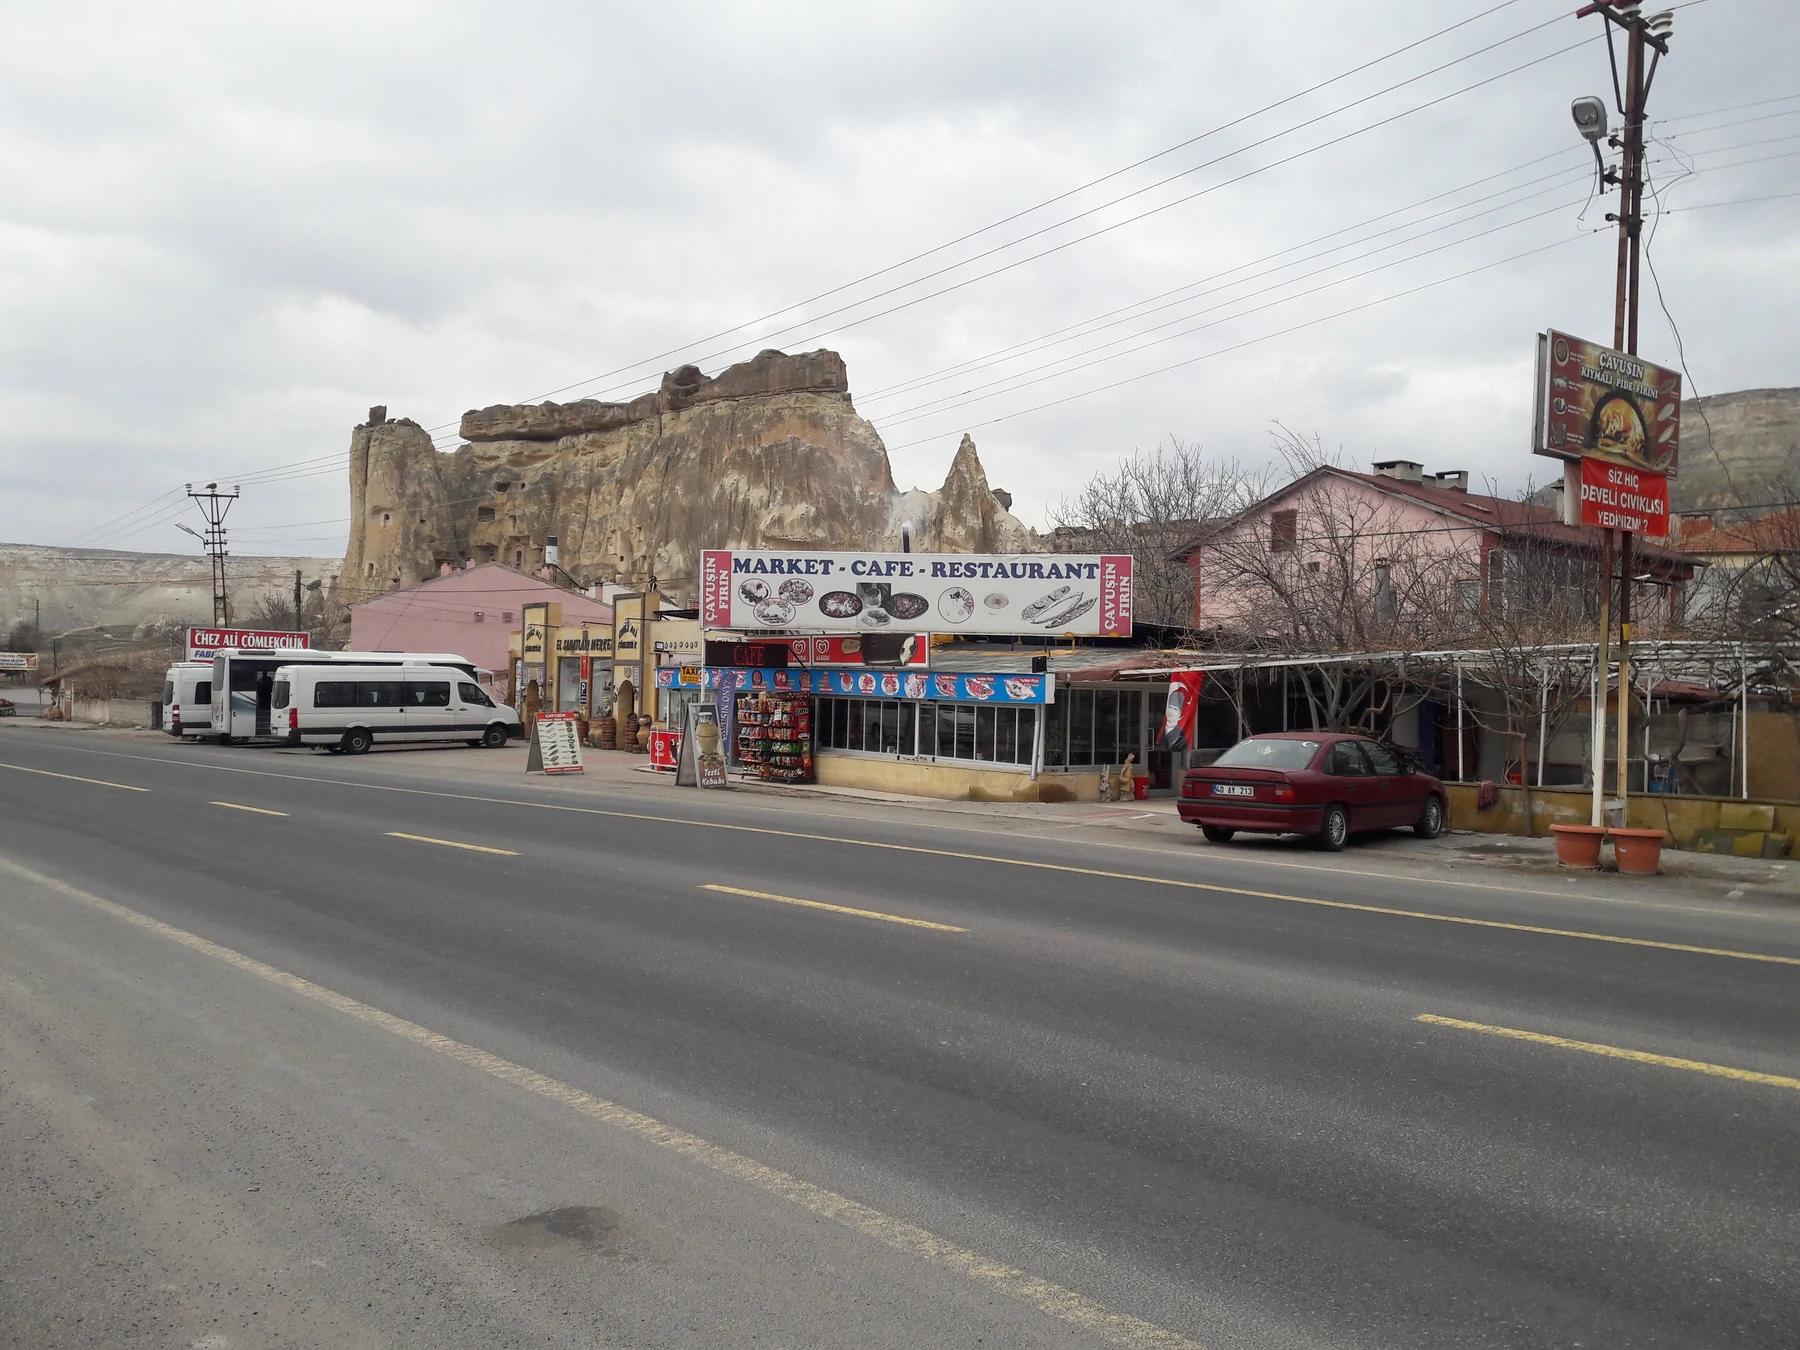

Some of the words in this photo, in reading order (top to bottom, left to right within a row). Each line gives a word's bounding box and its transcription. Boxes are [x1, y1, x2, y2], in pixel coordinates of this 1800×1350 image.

[1599, 352, 1644, 379] ÇAVUŞİN
[1581, 366, 1613, 385] KIYMALI
[1616, 376, 1633, 392] PİDE
[1636, 384, 1659, 399] FIRINI
[1608, 467, 1623, 485] SİZ
[1625, 470, 1639, 492] HİÇ
[1582, 484, 1618, 506] DEVELİ
[732, 558, 834, 575] MARKET
[851, 560, 913, 577] CAFE
[931, 562, 1100, 580] RESTAURANT
[705, 557, 717, 621] ÇAVUŞİN
[718, 569, 729, 609] FIRIN
[1104, 563, 1117, 630] ÇAVUŞİN
[1118, 575, 1131, 617] FIRIN
[195, 633, 220, 645] CHEZ
[223, 632, 238, 647] ALİ
[591, 638, 612, 651] MERKE
[734, 645, 764, 666] CAFE
[682, 667, 698, 675] TAXI
[704, 769, 720, 777] Testi
[1240, 787, 1252, 795] 213
